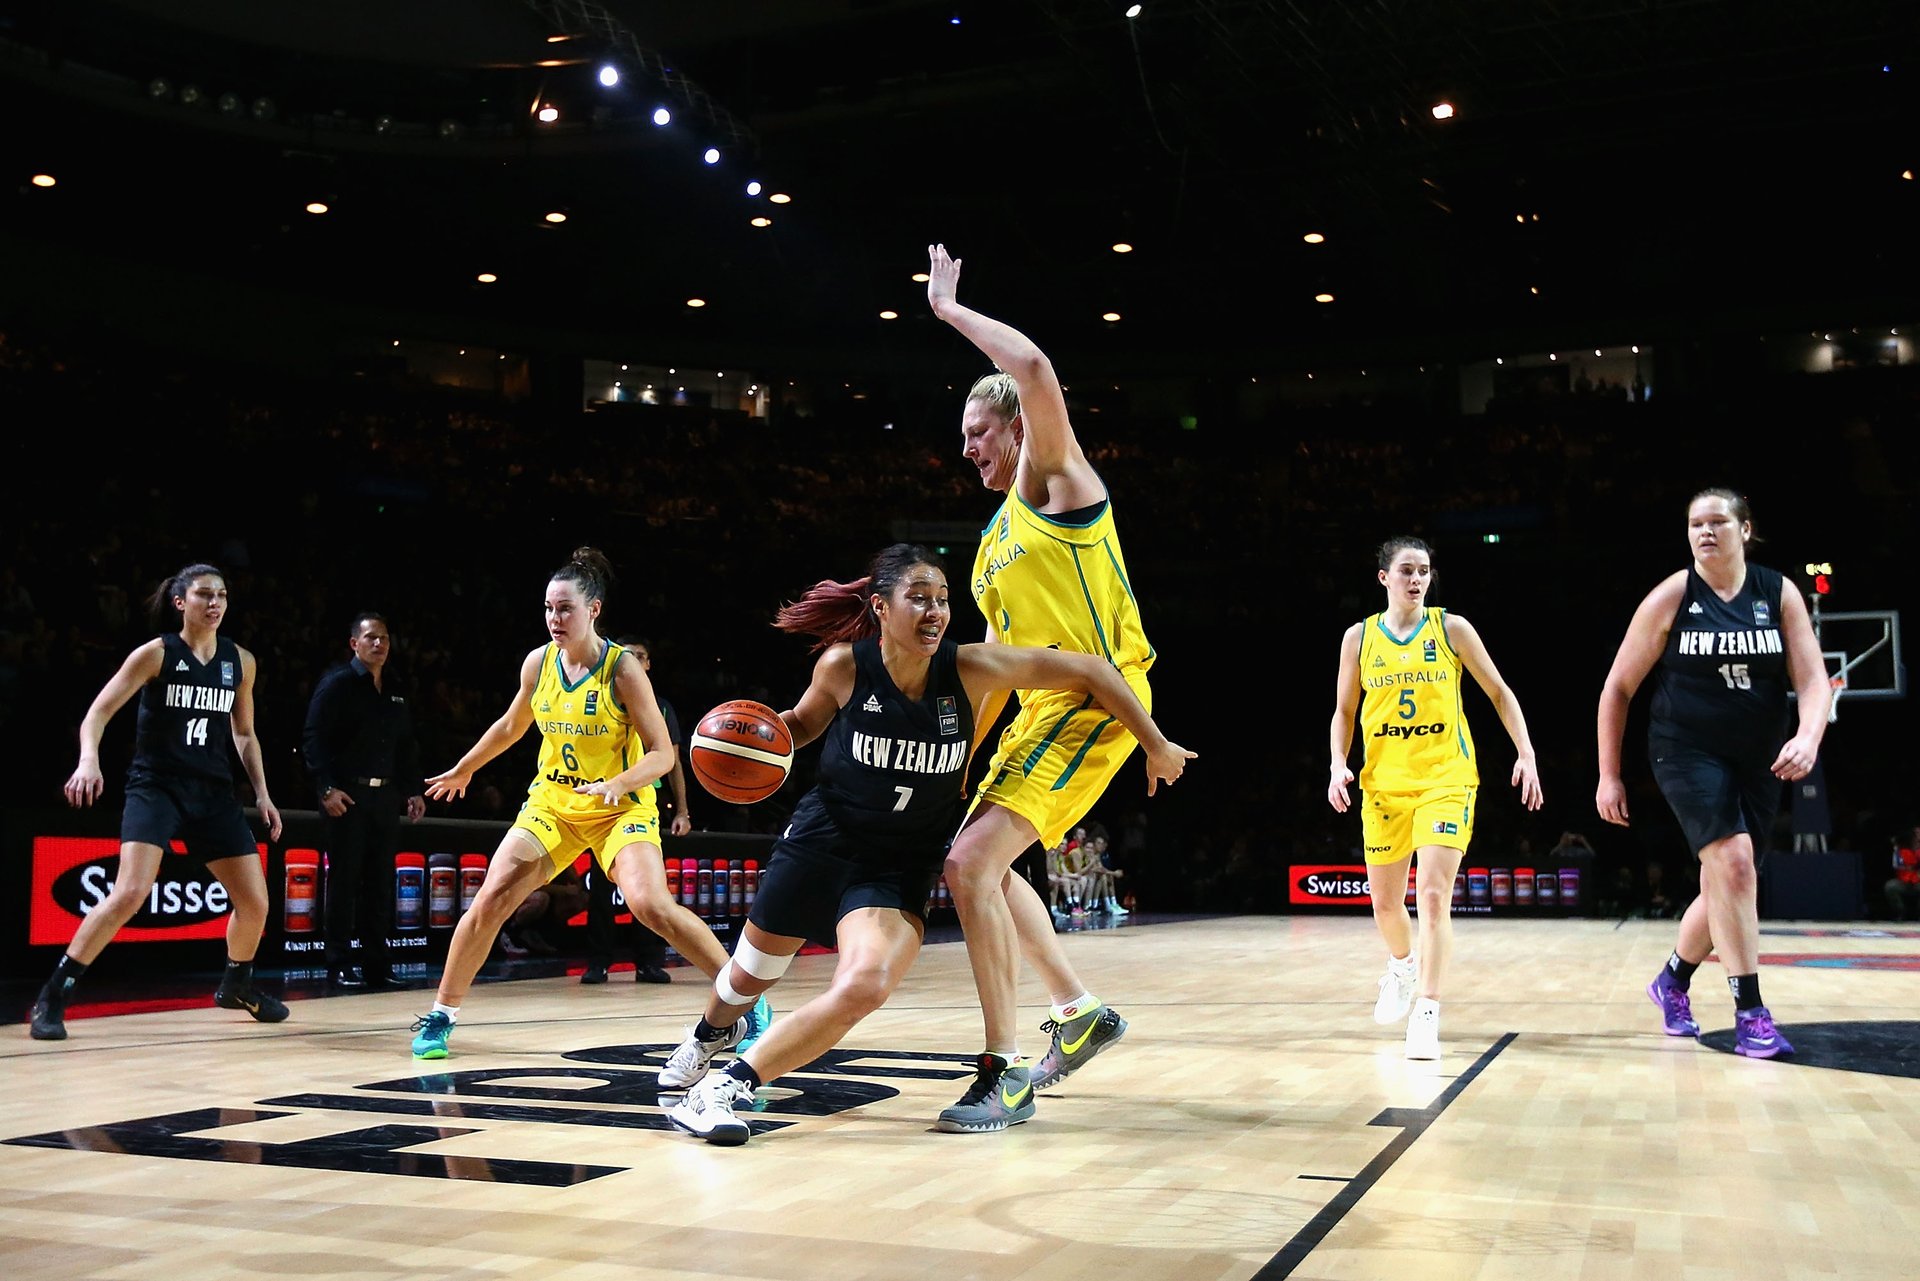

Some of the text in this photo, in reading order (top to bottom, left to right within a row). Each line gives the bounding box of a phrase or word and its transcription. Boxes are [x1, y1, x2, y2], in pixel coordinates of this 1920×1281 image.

[973, 543, 1026, 601] USTRALIA
[1679, 631, 1715, 655] NEW
[1718, 664, 1751, 689] 15
[166, 684, 194, 709] NEW
[1398, 689, 1416, 720] 5
[186, 718, 208, 746] 14
[1374, 723, 1446, 740] Jayco
[561, 743, 579, 771] 6
[852, 731, 967, 774] NEW ZEALAND
[892, 786, 913, 811] 7
[80, 865, 228, 914] Sisse
[1307, 875, 1371, 895] Swisse
